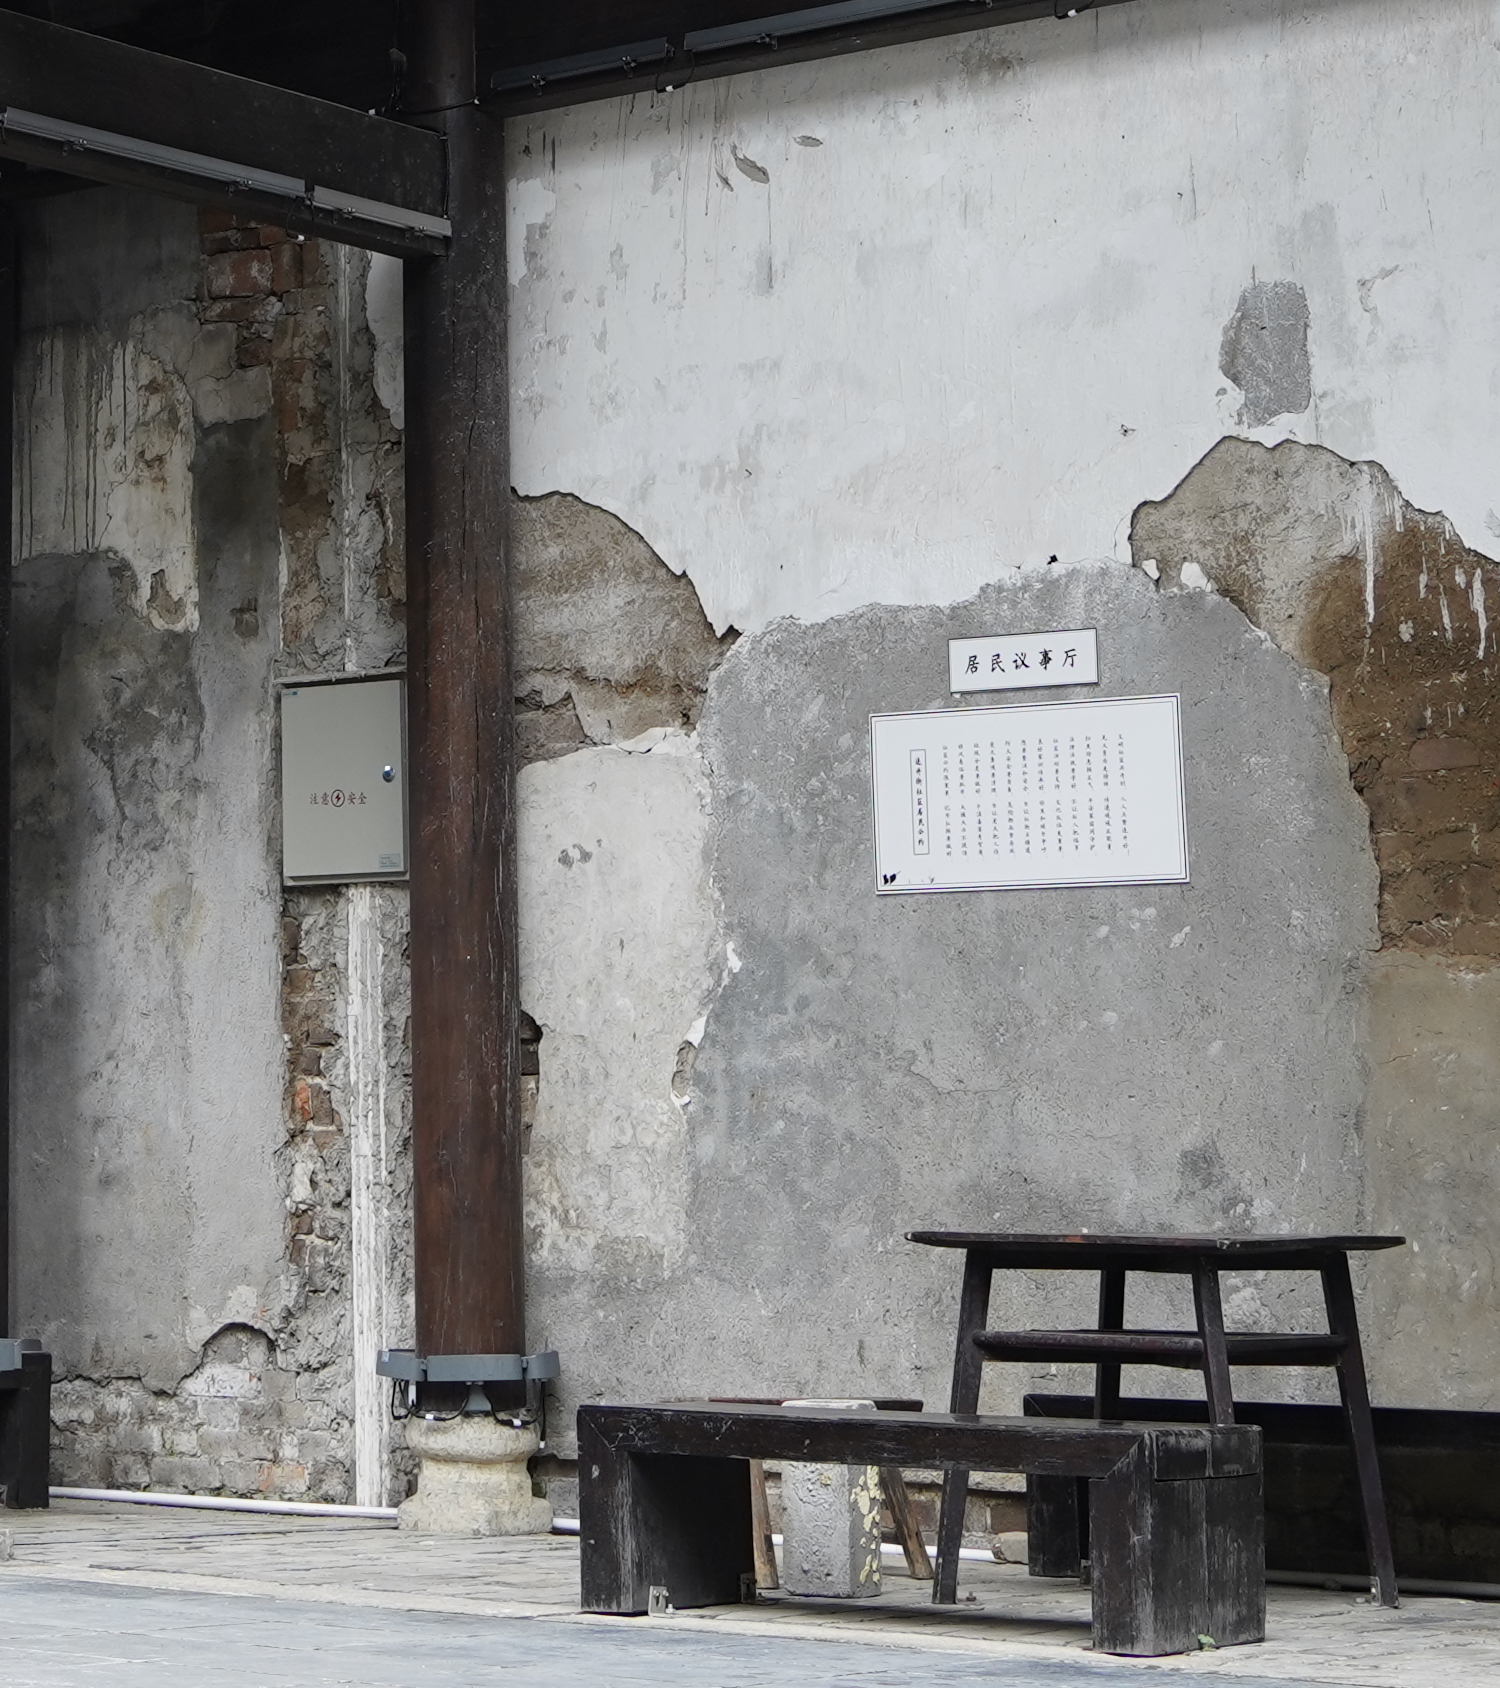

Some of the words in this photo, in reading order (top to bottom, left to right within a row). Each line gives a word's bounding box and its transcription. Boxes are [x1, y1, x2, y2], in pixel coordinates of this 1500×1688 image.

[964, 648, 1078, 675] 居民议事厅
[309, 792, 330, 805] 注意
[347, 791, 367, 805] 安全
